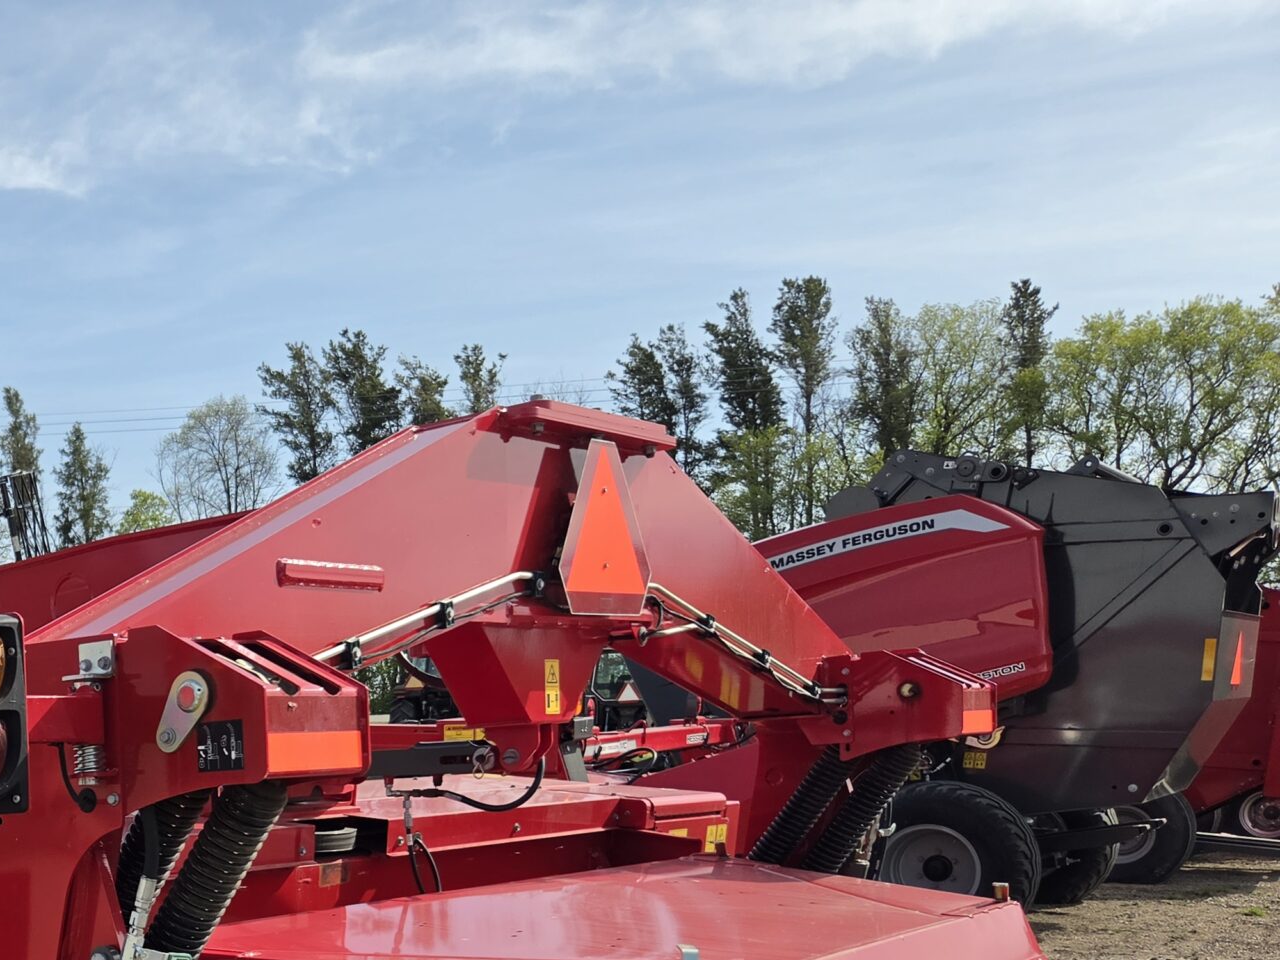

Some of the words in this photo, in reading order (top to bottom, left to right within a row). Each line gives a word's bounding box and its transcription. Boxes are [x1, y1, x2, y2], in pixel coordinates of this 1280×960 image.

[770, 541, 837, 569] MASSEY
[842, 518, 935, 549] FERGUSON
[977, 662, 1026, 680] STON
